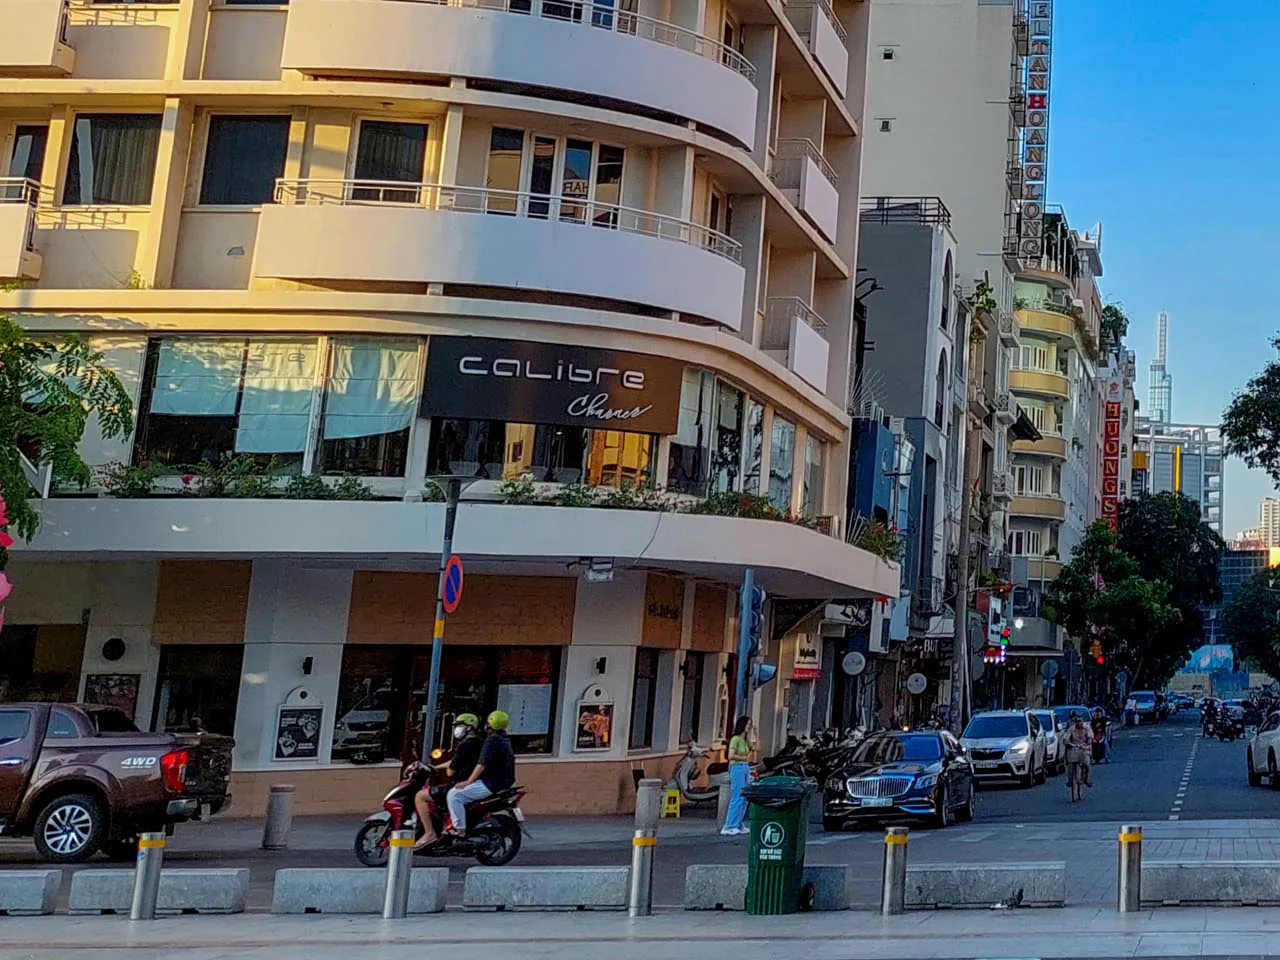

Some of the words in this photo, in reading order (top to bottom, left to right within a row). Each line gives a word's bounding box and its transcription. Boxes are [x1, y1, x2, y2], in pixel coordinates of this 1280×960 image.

[1029, 40, 1049, 90] TAN
[1025, 94, 1047, 179] HOANG
[1022, 184, 1043, 256] LONG
[121, 757, 156, 765] 4WD
